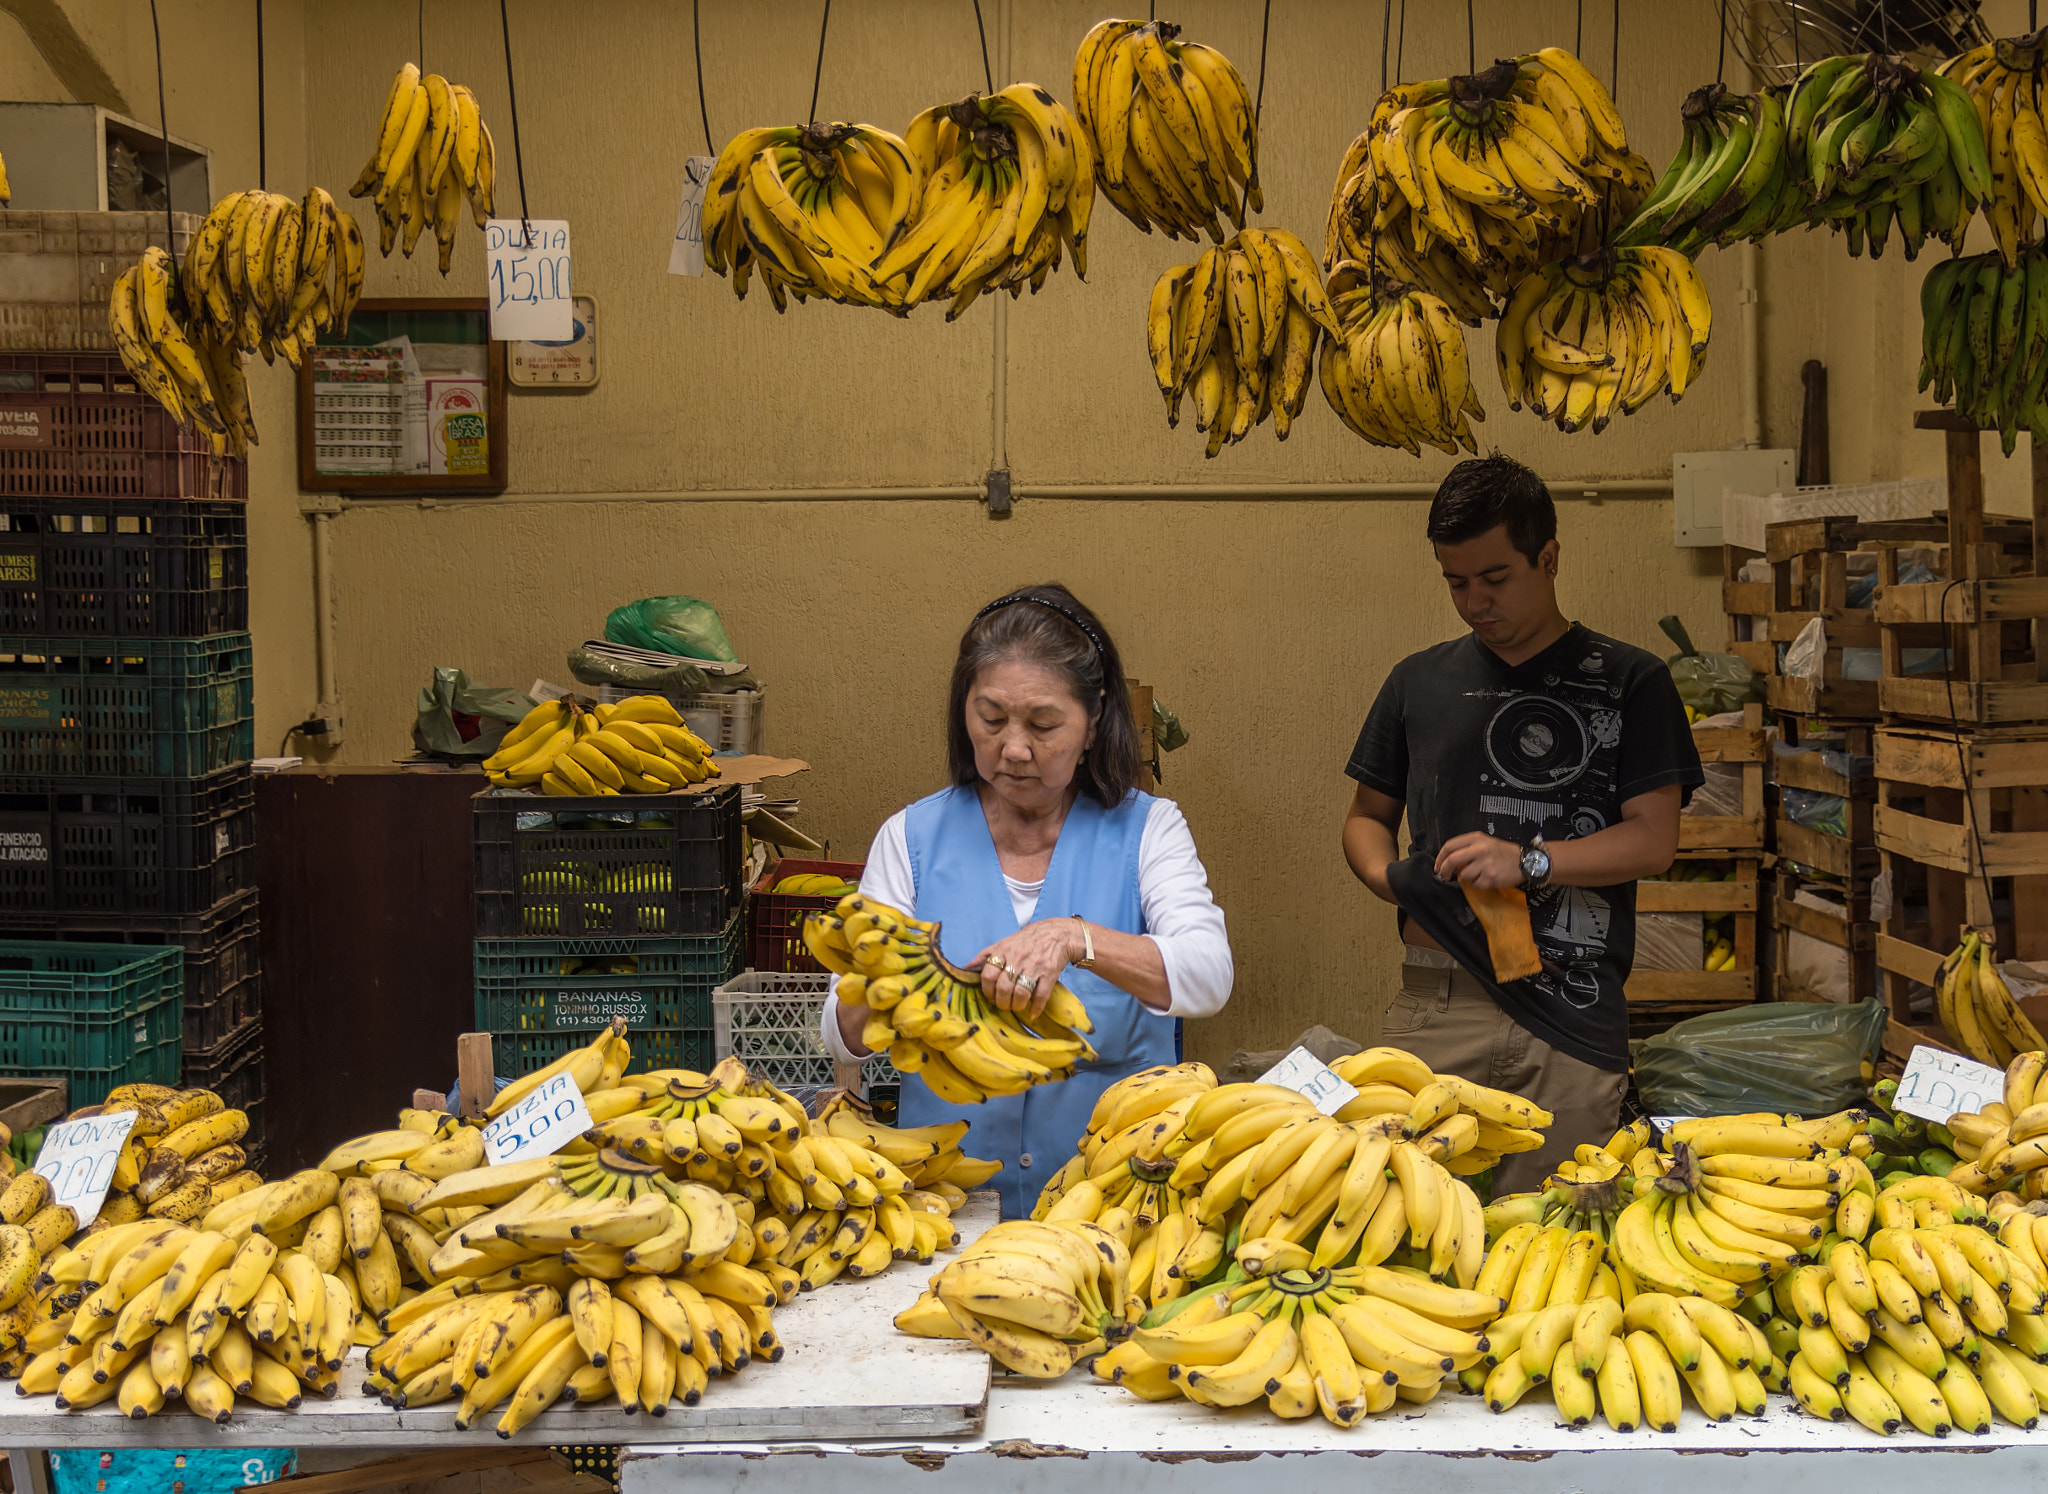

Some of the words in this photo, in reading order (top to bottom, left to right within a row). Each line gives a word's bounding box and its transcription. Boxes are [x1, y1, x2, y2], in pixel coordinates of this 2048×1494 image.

[486, 225, 567, 251] DUZIA
[490, 256, 572, 311] 15,00
[452, 417, 481, 429] MESA
[452, 427, 484, 439] BRASIL
[8, 847, 48, 861] ATACADO
[557, 991, 642, 1002] BANANAS
[553, 1004, 600, 1015] TONINHO
[556, 1016, 579, 1026] (11)
